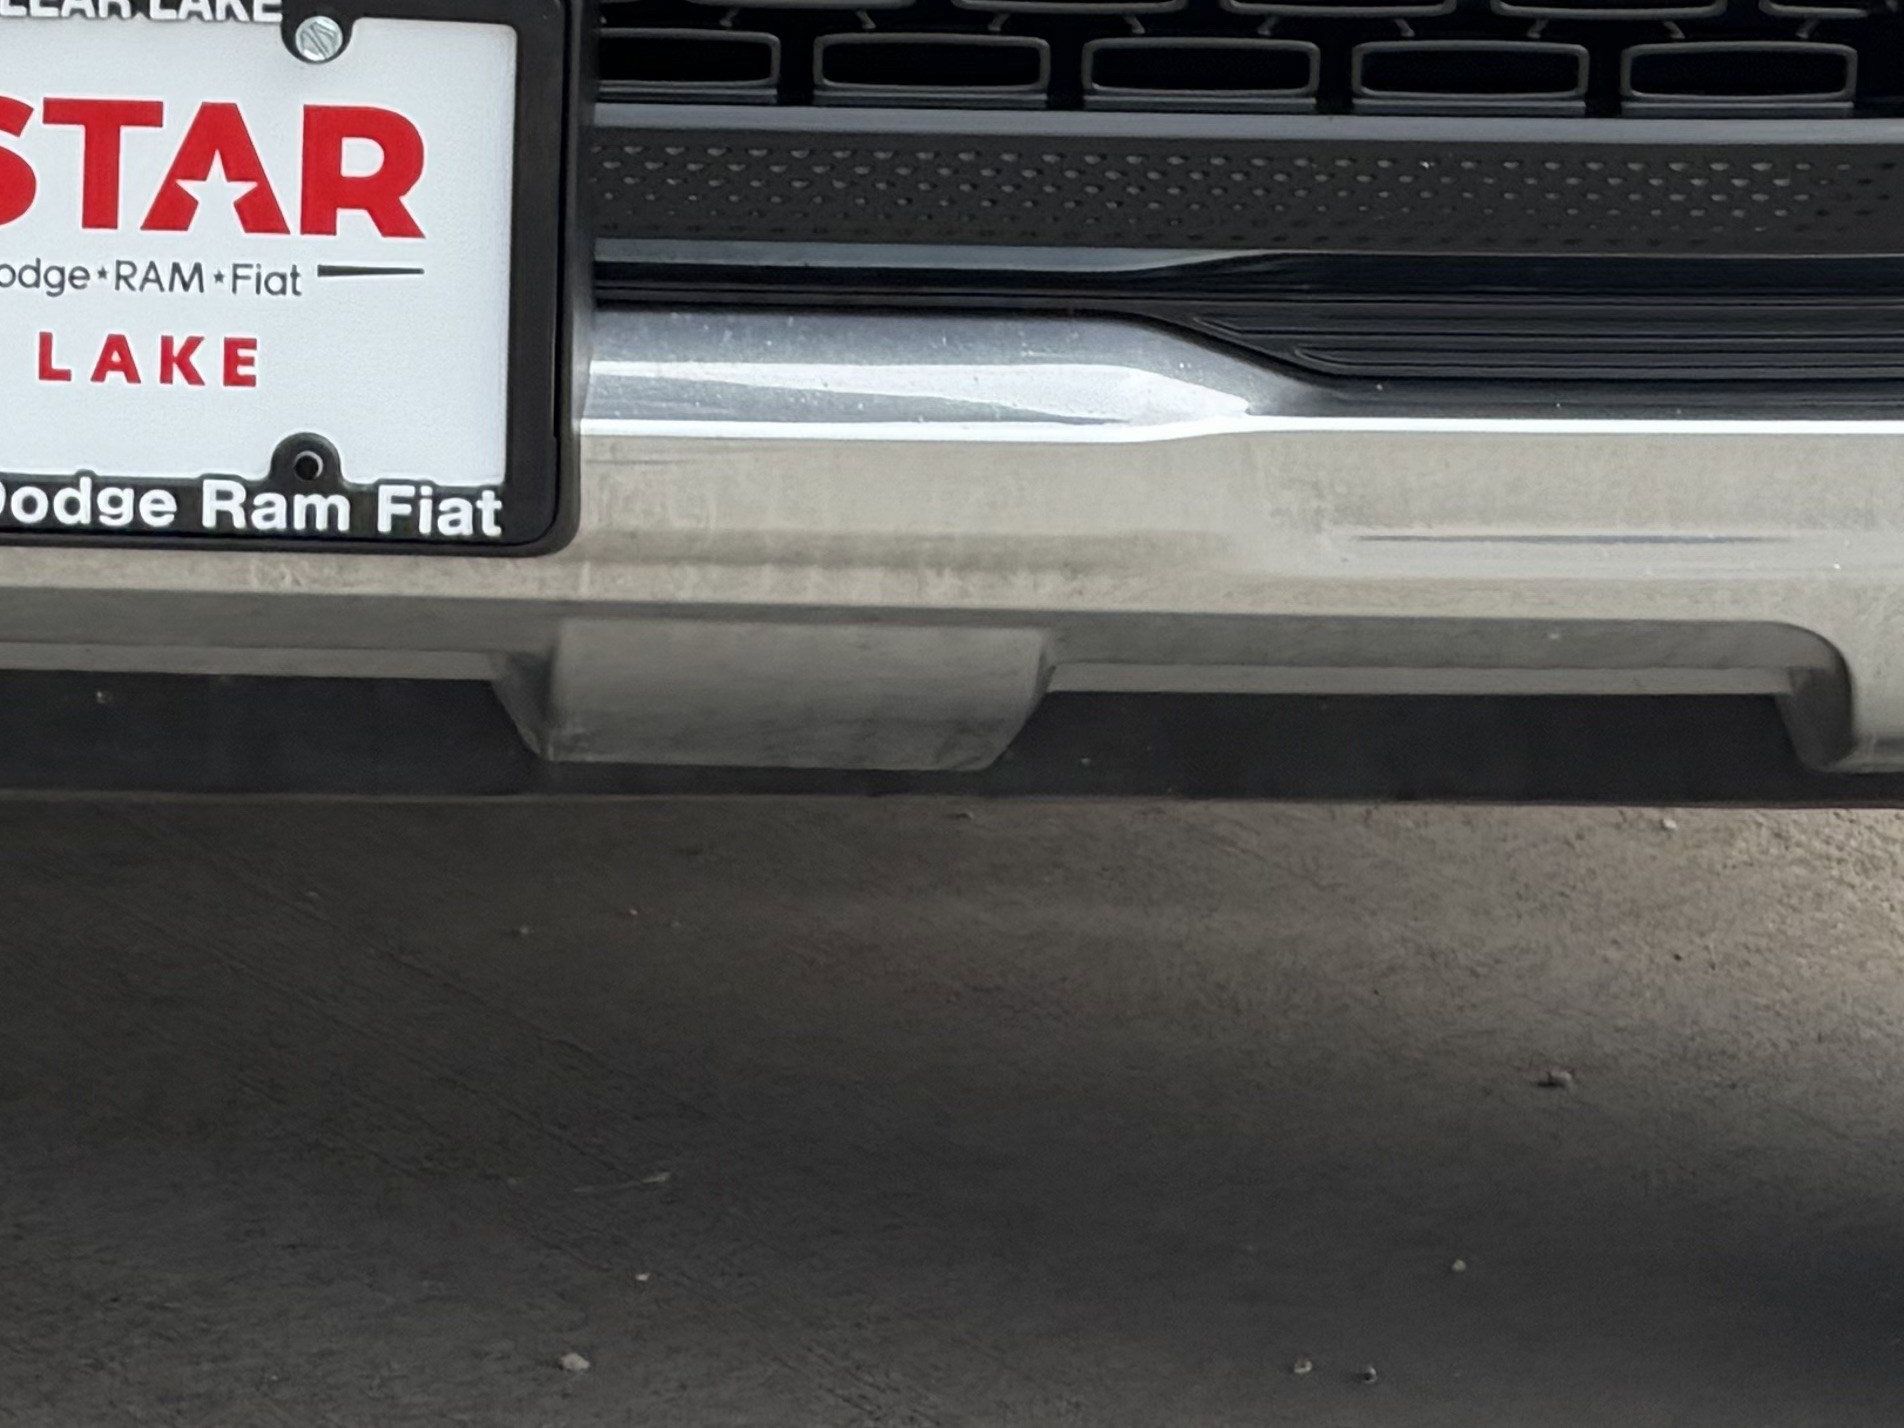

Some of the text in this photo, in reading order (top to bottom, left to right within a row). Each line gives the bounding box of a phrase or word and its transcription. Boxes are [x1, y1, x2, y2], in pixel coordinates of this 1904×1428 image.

[114, 259, 205, 294] RAM
[231, 261, 302, 296] Fiat
[38, 331, 259, 388] LAKE
[202, 480, 351, 533] Ram
[376, 486, 503, 537] Fiat
